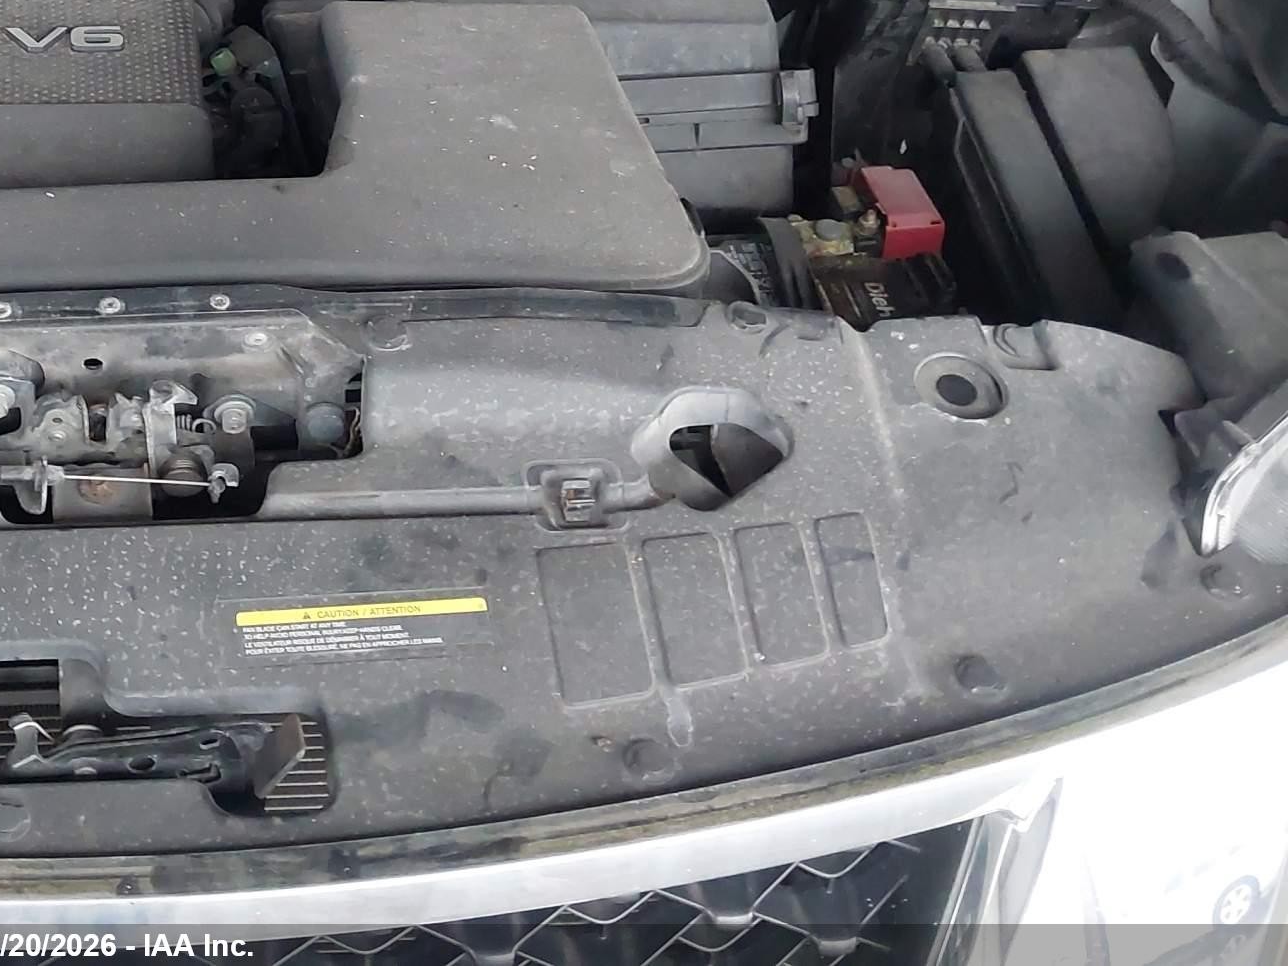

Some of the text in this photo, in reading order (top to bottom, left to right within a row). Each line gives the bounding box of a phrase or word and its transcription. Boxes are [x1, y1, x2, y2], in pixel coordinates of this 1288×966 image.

[4, 25, 124, 51] V6
[316, 609, 360, 619] CAUTION
[369, 605, 421, 617] ATTENTION
